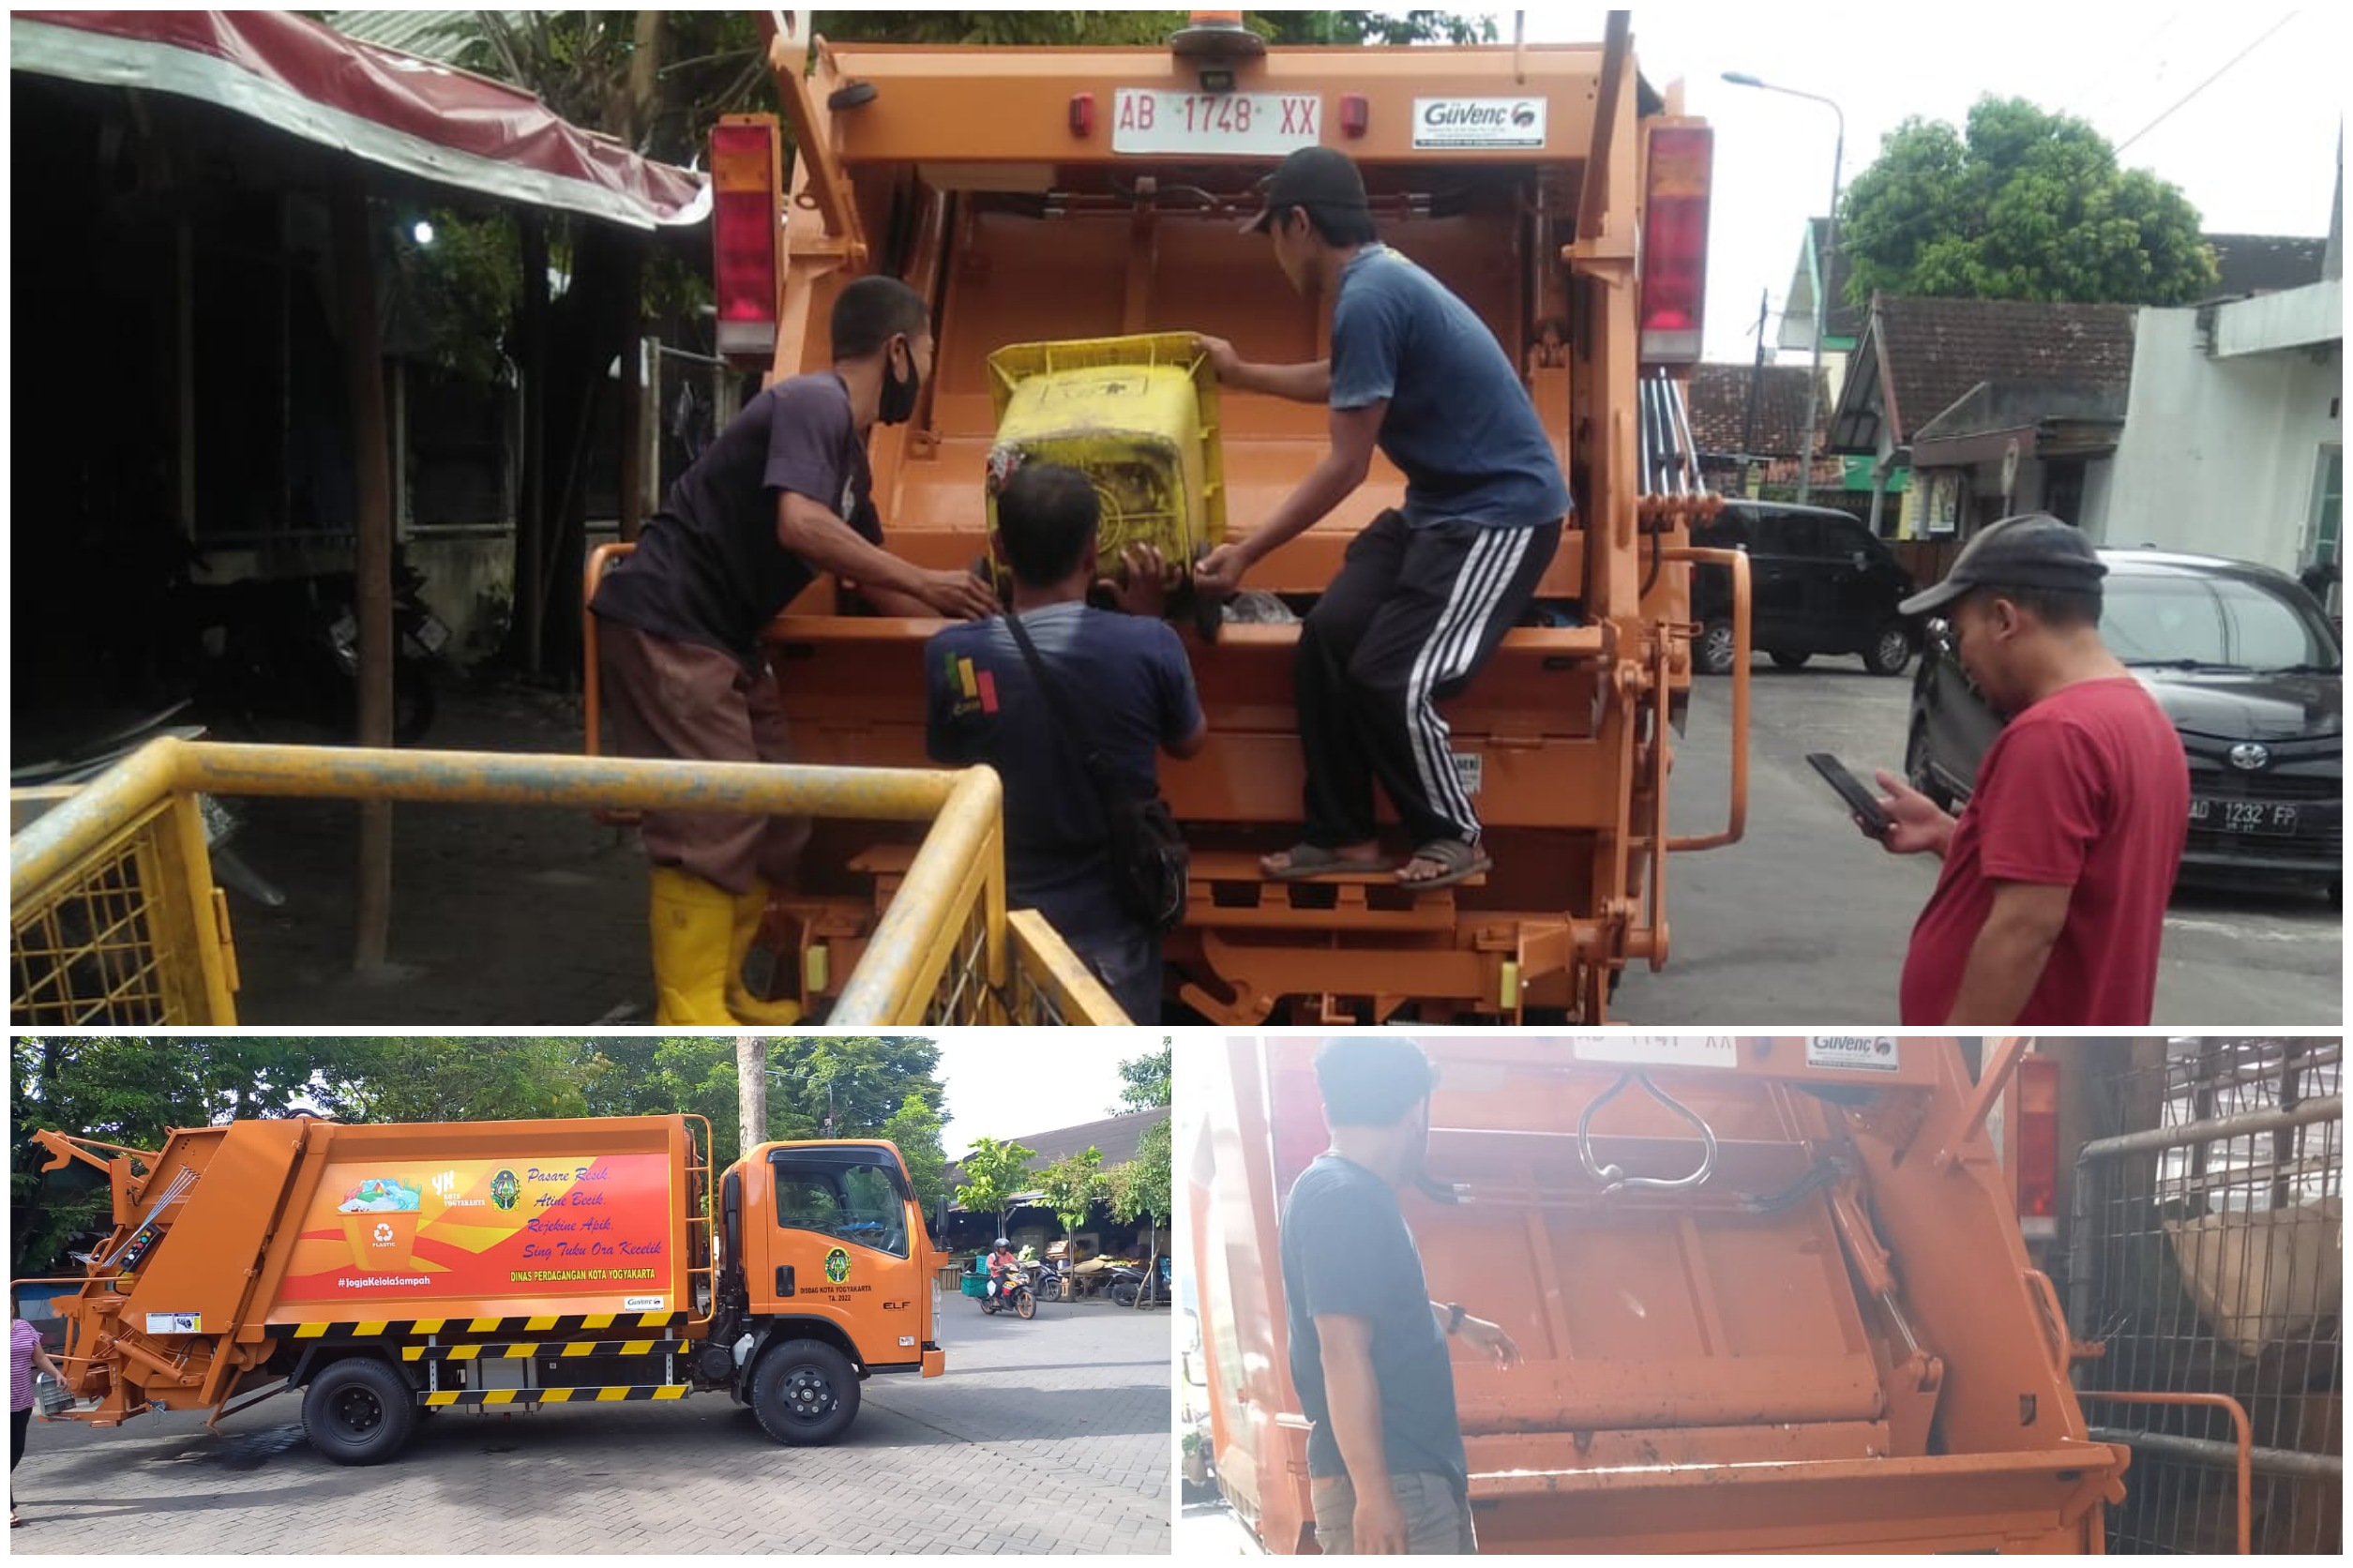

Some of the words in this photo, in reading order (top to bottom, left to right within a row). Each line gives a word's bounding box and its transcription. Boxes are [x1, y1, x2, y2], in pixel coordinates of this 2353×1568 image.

[1119, 95, 1154, 130] AB
[1184, 97, 1251, 133] 1748
[1279, 98, 1316, 135] XX
[2225, 802, 2264, 823] 1232
[2272, 806, 2296, 825] FP
[527, 1168, 569, 1183] Pasare
[534, 1193, 566, 1207] Atine
[527, 1218, 577, 1235] Rejekine
[522, 1244, 552, 1260] Sing
[556, 1242, 586, 1257] Tuku
[591, 1242, 613, 1256] Ora
[619, 1240, 662, 1256] Kecelik
[338, 1275, 430, 1289] #JogjaKelolaSampah
[510, 1271, 533, 1282] DINAS
[534, 1270, 586, 1281] PERDAGANGAN
[588, 1269, 607, 1280] KOTA
[609, 1268, 656, 1279] YOGYAKARTA
[836, 1285, 872, 1293] YOGYAKARTA
